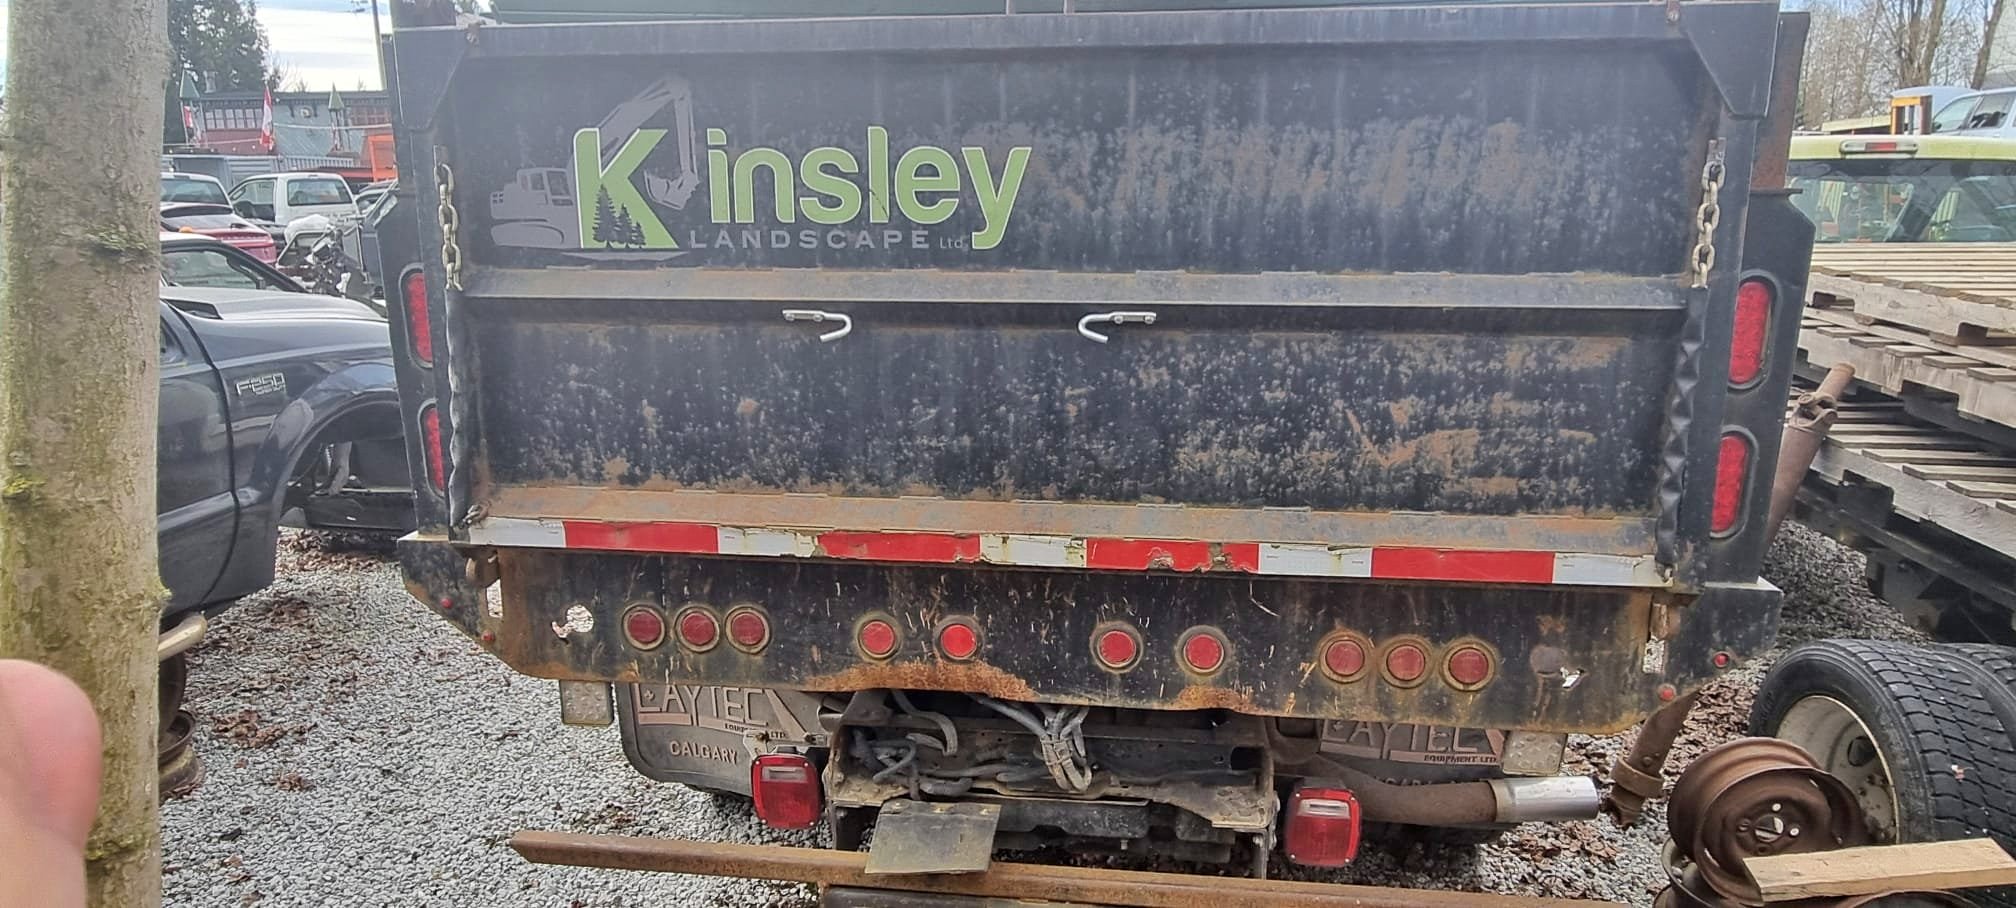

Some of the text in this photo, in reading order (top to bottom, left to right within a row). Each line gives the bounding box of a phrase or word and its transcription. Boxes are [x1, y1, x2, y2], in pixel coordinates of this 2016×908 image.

[573, 126, 1032, 250] Kinsley
[689, 230, 930, 249] LANDSCAPE
[669, 740, 738, 765] CALGARY
